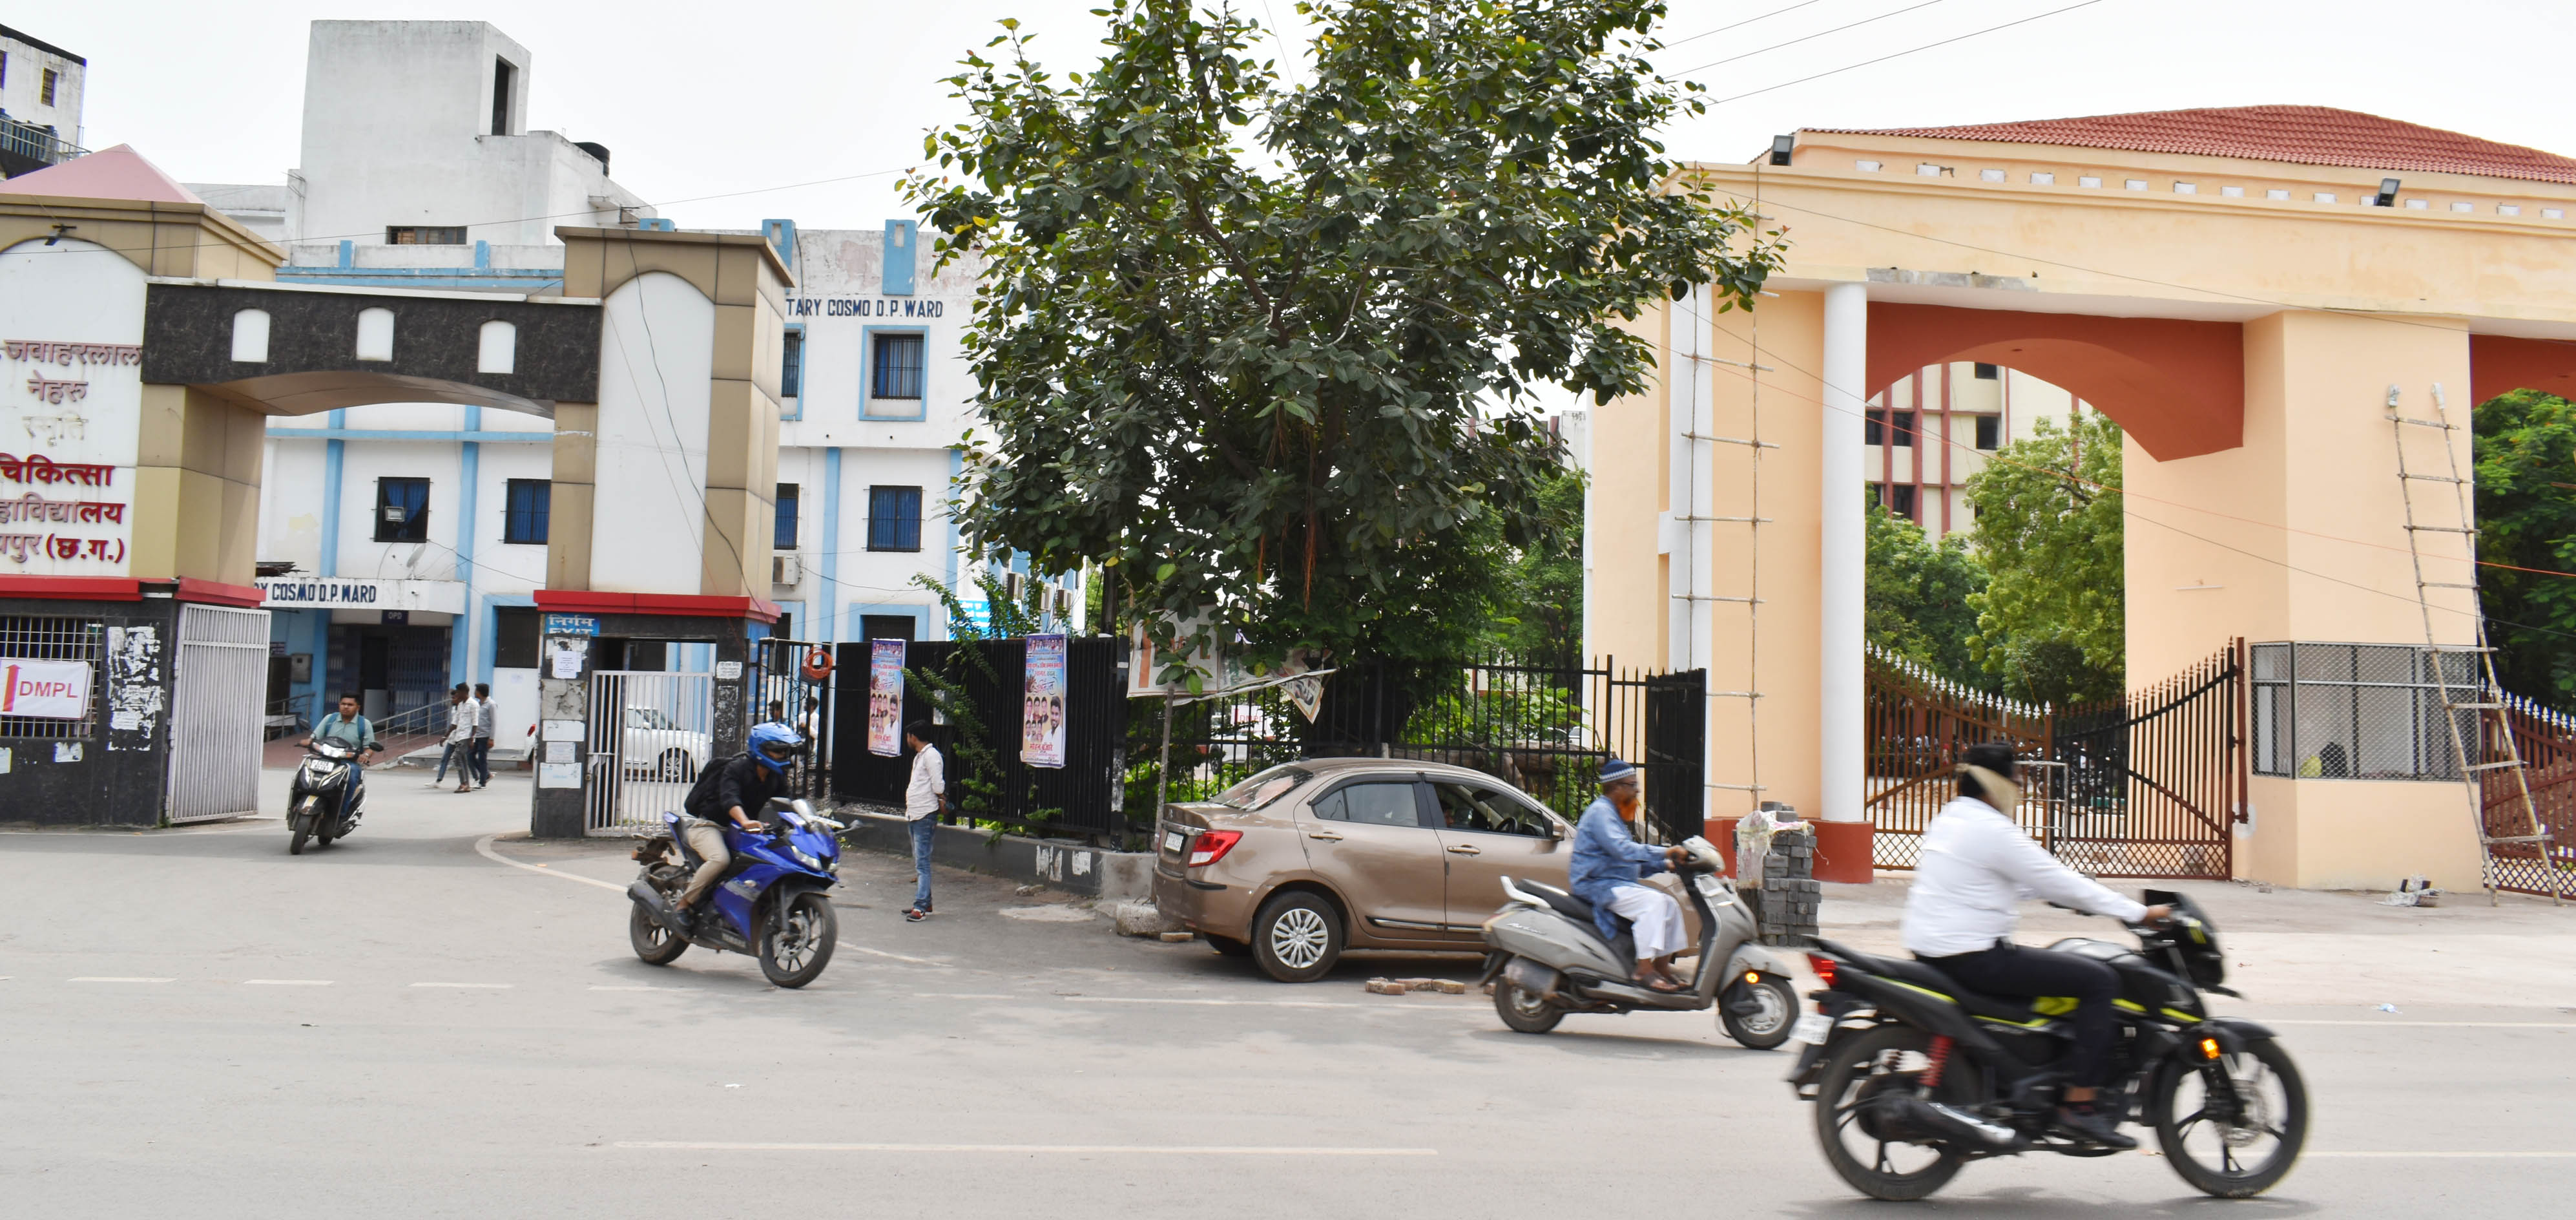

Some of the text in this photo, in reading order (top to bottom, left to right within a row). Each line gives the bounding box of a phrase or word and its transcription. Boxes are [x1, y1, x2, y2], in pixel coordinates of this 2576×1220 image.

[827, 299, 870, 317] COSMO
[4, 339, 142, 366] जवाहरलाल
[0, 452, 115, 487] चिकित्सा
[0, 491, 126, 525] हाविद्यालय
[46, 532, 125, 563] (छ.ग.)
[271, 584, 316, 602] COSMO
[342, 585, 377, 603] WARD
[549, 615, 594, 626] निर्गम
[19, 680, 78, 699] DMPL
